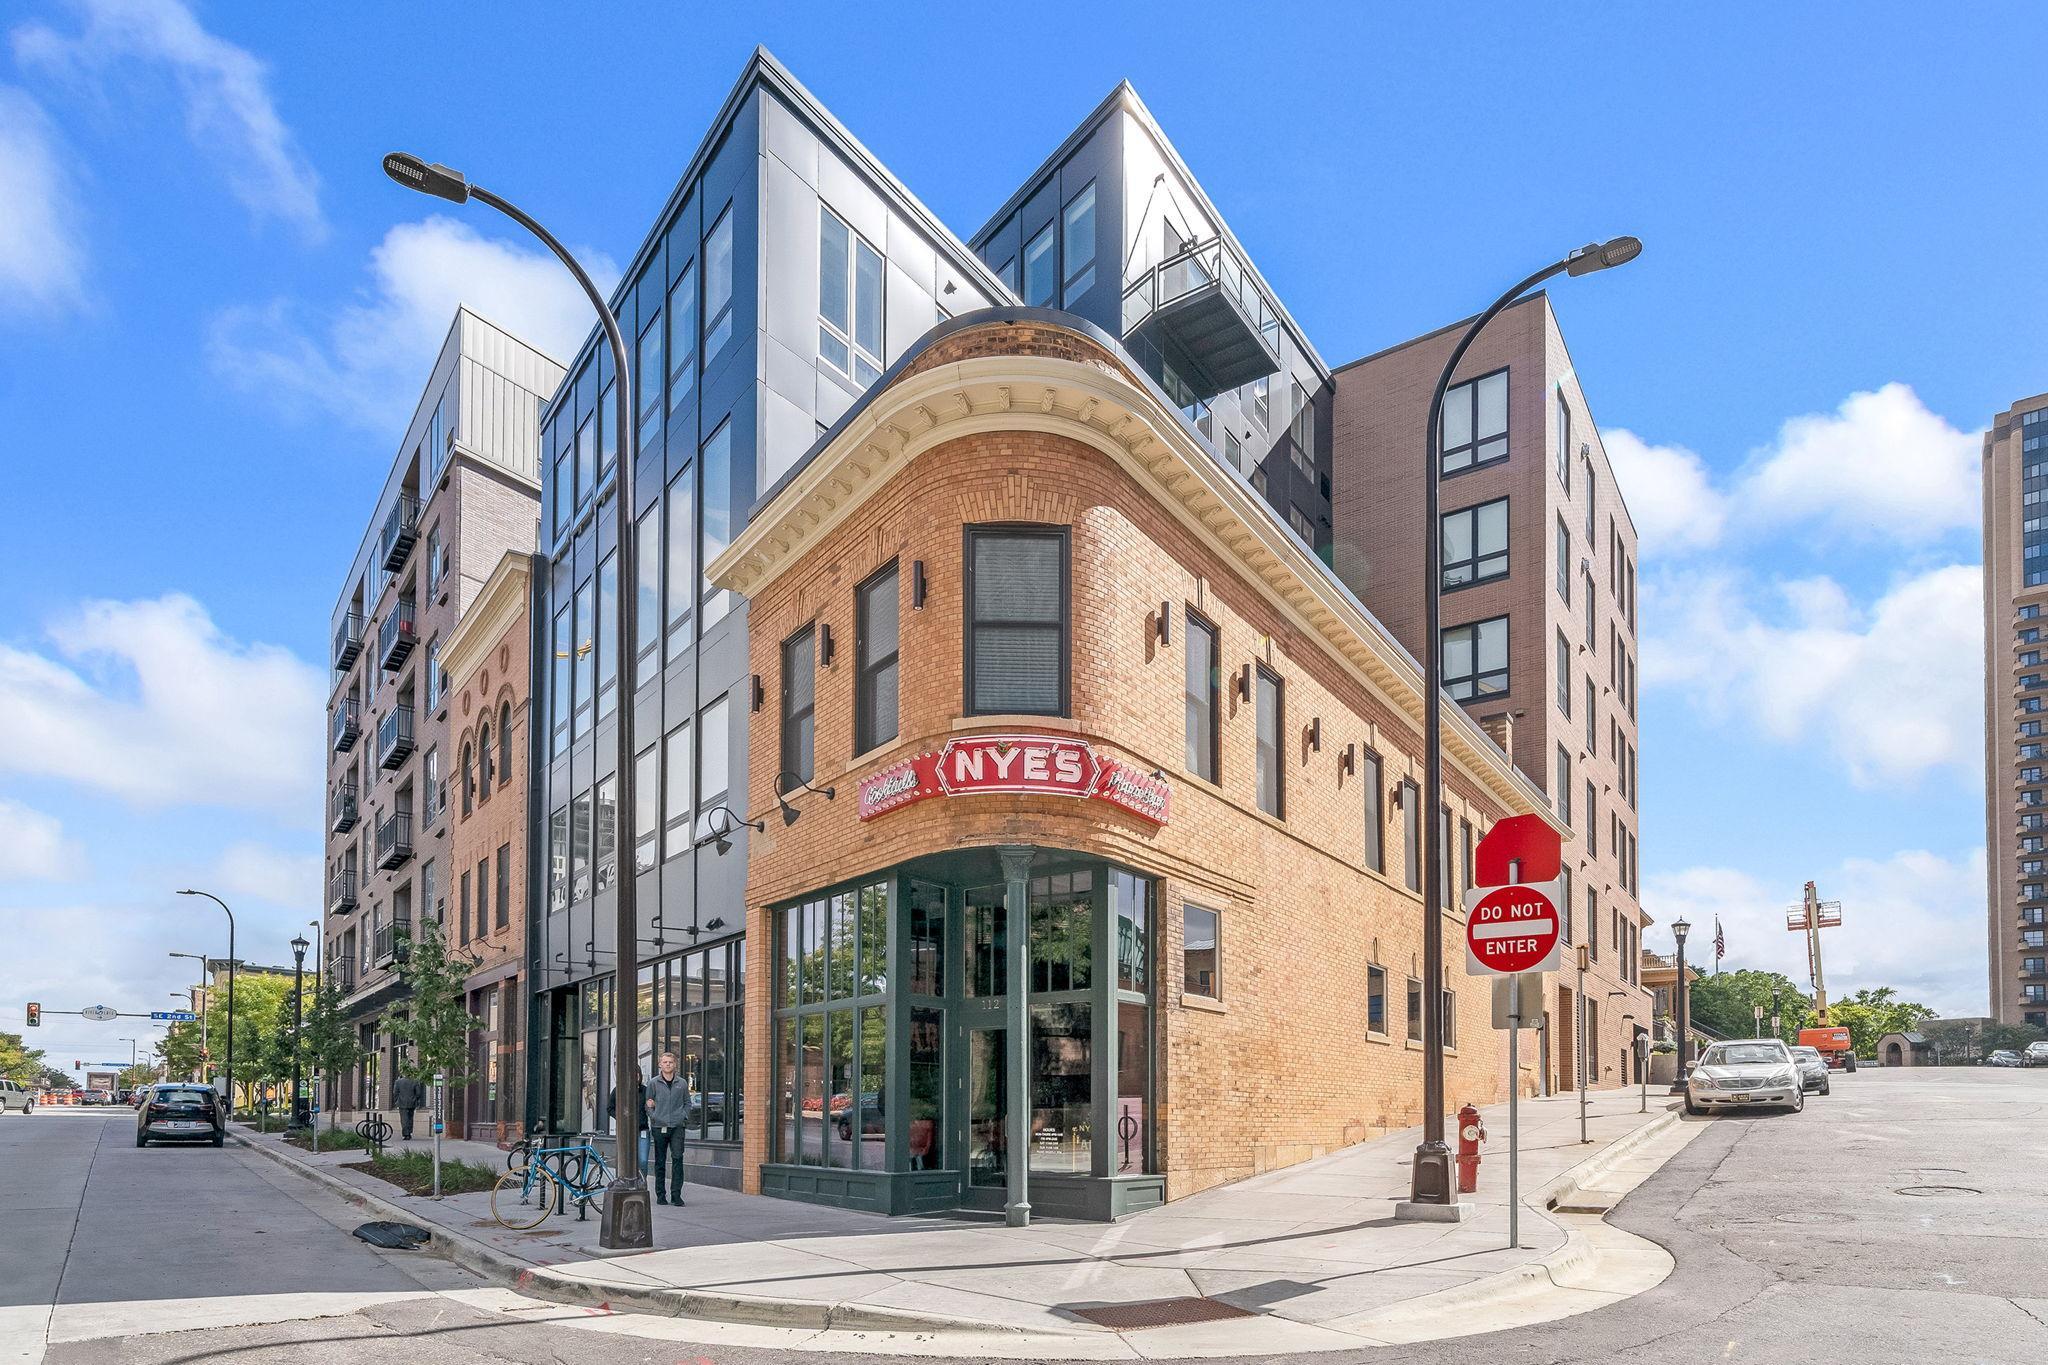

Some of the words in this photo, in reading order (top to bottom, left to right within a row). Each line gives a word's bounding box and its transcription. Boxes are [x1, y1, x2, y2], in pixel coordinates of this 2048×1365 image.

[956, 744, 1083, 783] NYE'S
[864, 770, 919, 805] Cocktails
[1481, 906, 1502, 920] DO
[1511, 902, 1543, 918] NOT
[1486, 939, 1537, 955] ENTER
[982, 999, 1000, 1010] 112
